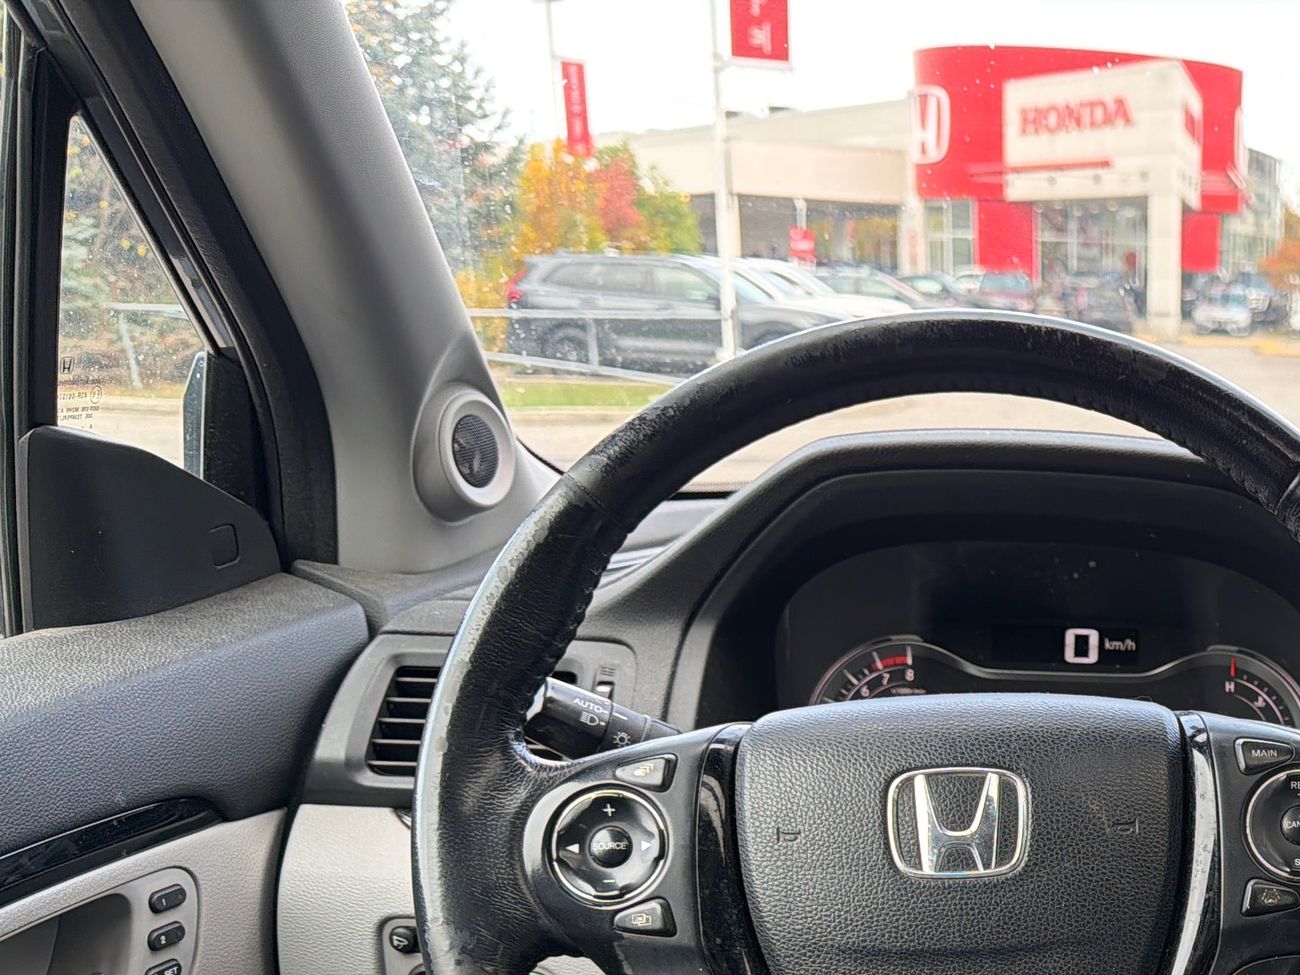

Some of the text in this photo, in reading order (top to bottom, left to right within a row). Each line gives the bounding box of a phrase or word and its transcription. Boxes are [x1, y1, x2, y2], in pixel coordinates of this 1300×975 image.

[1020, 97, 1132, 136] HONDA
[1064, 628, 1136, 664] 0 km/h
[882, 672, 891, 685] 7
[905, 668, 915, 681] 8
[860, 685, 870, 697] 6
[1225, 681, 1236, 693] H
[573, 698, 604, 714] AUTO
[1252, 749, 1278, 757] MAIN
[592, 842, 628, 850] SOURCE
[160, 936, 166, 944] 2
